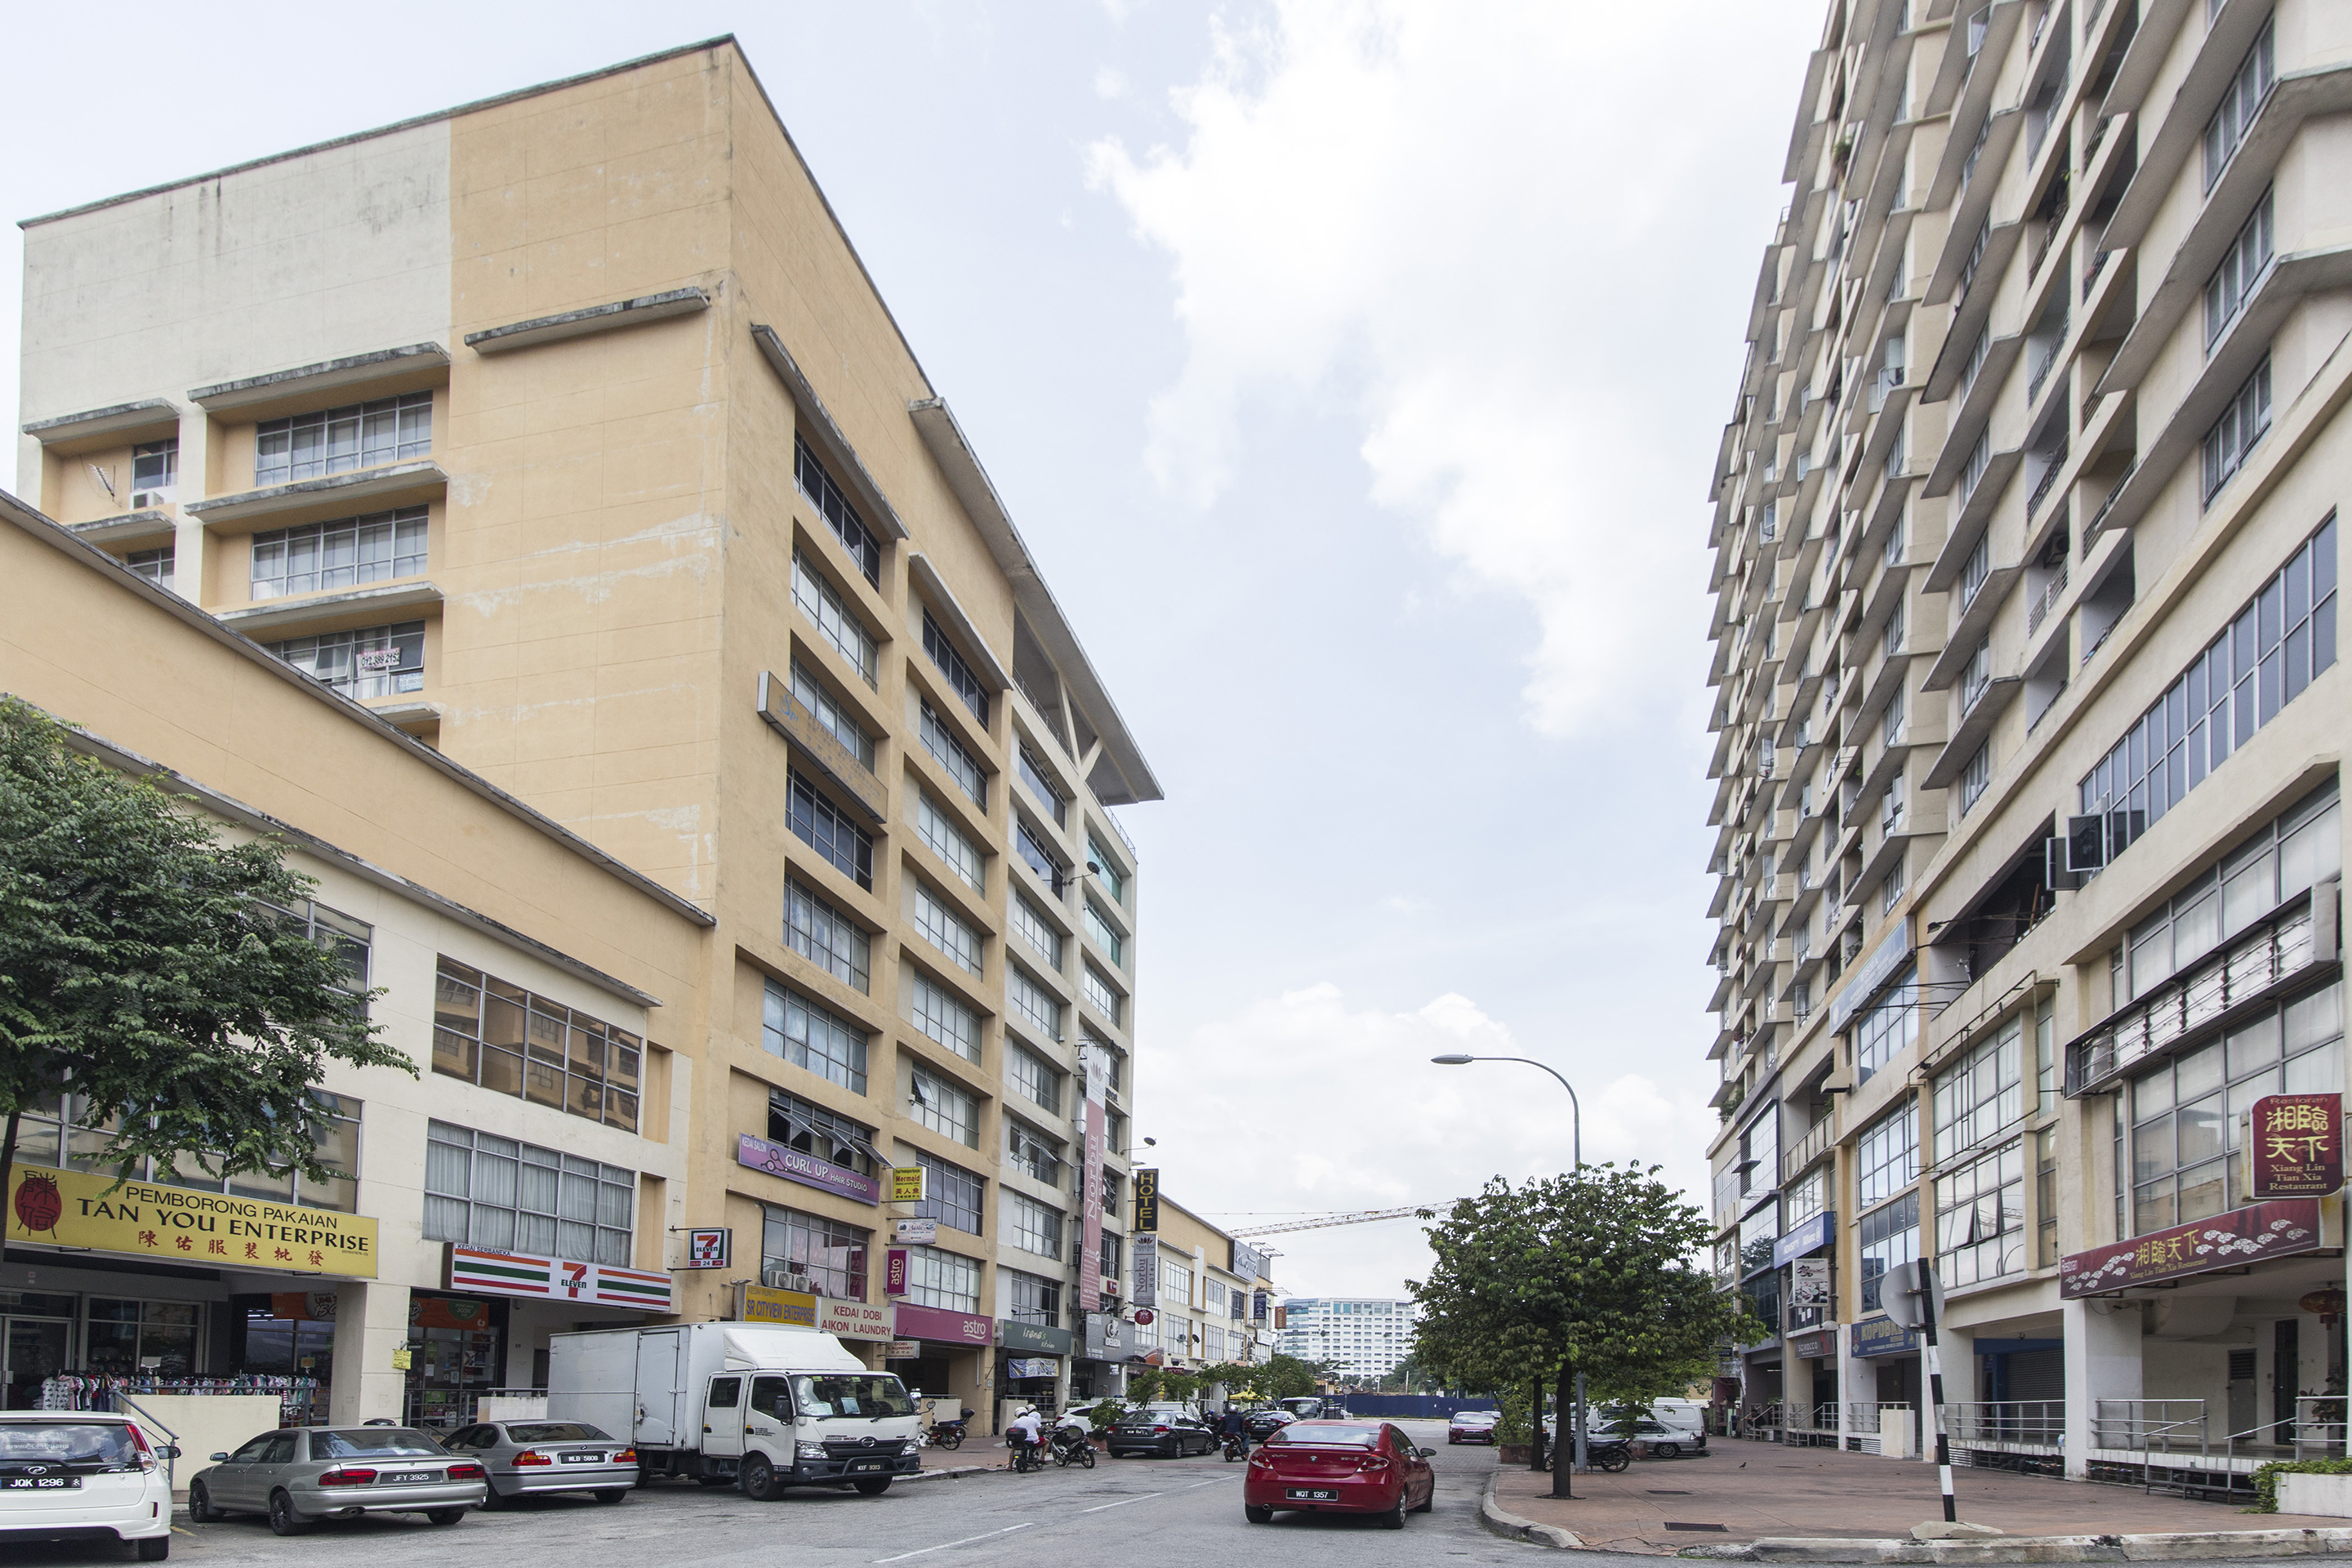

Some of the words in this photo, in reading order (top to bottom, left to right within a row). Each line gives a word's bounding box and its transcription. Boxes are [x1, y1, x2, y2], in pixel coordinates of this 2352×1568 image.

[2265, 1135, 2330, 1163] 天下
[785, 1153, 813, 1174] CURL
[815, 1163, 830, 1178] UP
[830, 1173, 846, 1184] HAIR
[846, 1178, 869, 1193] STUDIO
[1086, 1134, 1098, 1222] Norbu
[2270, 1164, 2303, 1174] Xiang
[2305, 1163, 2326, 1172] Lin
[2274, 1174, 2300, 1182] Tian
[2302, 1173, 2322, 1181] Xia
[2270, 1183, 2328, 1191] Restaurant
[126, 1186, 257, 1218] PEMBORONG
[264, 1207, 337, 1229] PAKAIAN
[1139, 1174, 1154, 1230] HOTEL
[76, 1198, 139, 1223] TAN
[156, 1209, 216, 1232] YOU
[229, 1219, 369, 1252] ENTERPRISE
[457, 1243, 476, 1252] KEDAI
[476, 1245, 512, 1256] SERBANEKA
[697, 1234, 719, 1259] 7
[562, 1261, 587, 1298] 7
[890, 1258, 901, 1285] astro
[1135, 1258, 1146, 1294] Norbu
[746, 1298, 755, 1316] SR
[756, 1300, 783, 1319] CITYVIEW
[783, 1303, 815, 1323] ENTERPRISE
[833, 1305, 859, 1318] KEDAI
[862, 1309, 882, 1321] DOBI
[821, 1320, 849, 1332] AIKON
[853, 1323, 892, 1337] LAUNDRY
[963, 1320, 987, 1335] astro
[1022, 1326, 1047, 1340] Irene's
[10, 1478, 33, 1488] JQK
[38, 1477, 65, 1487] 1296
